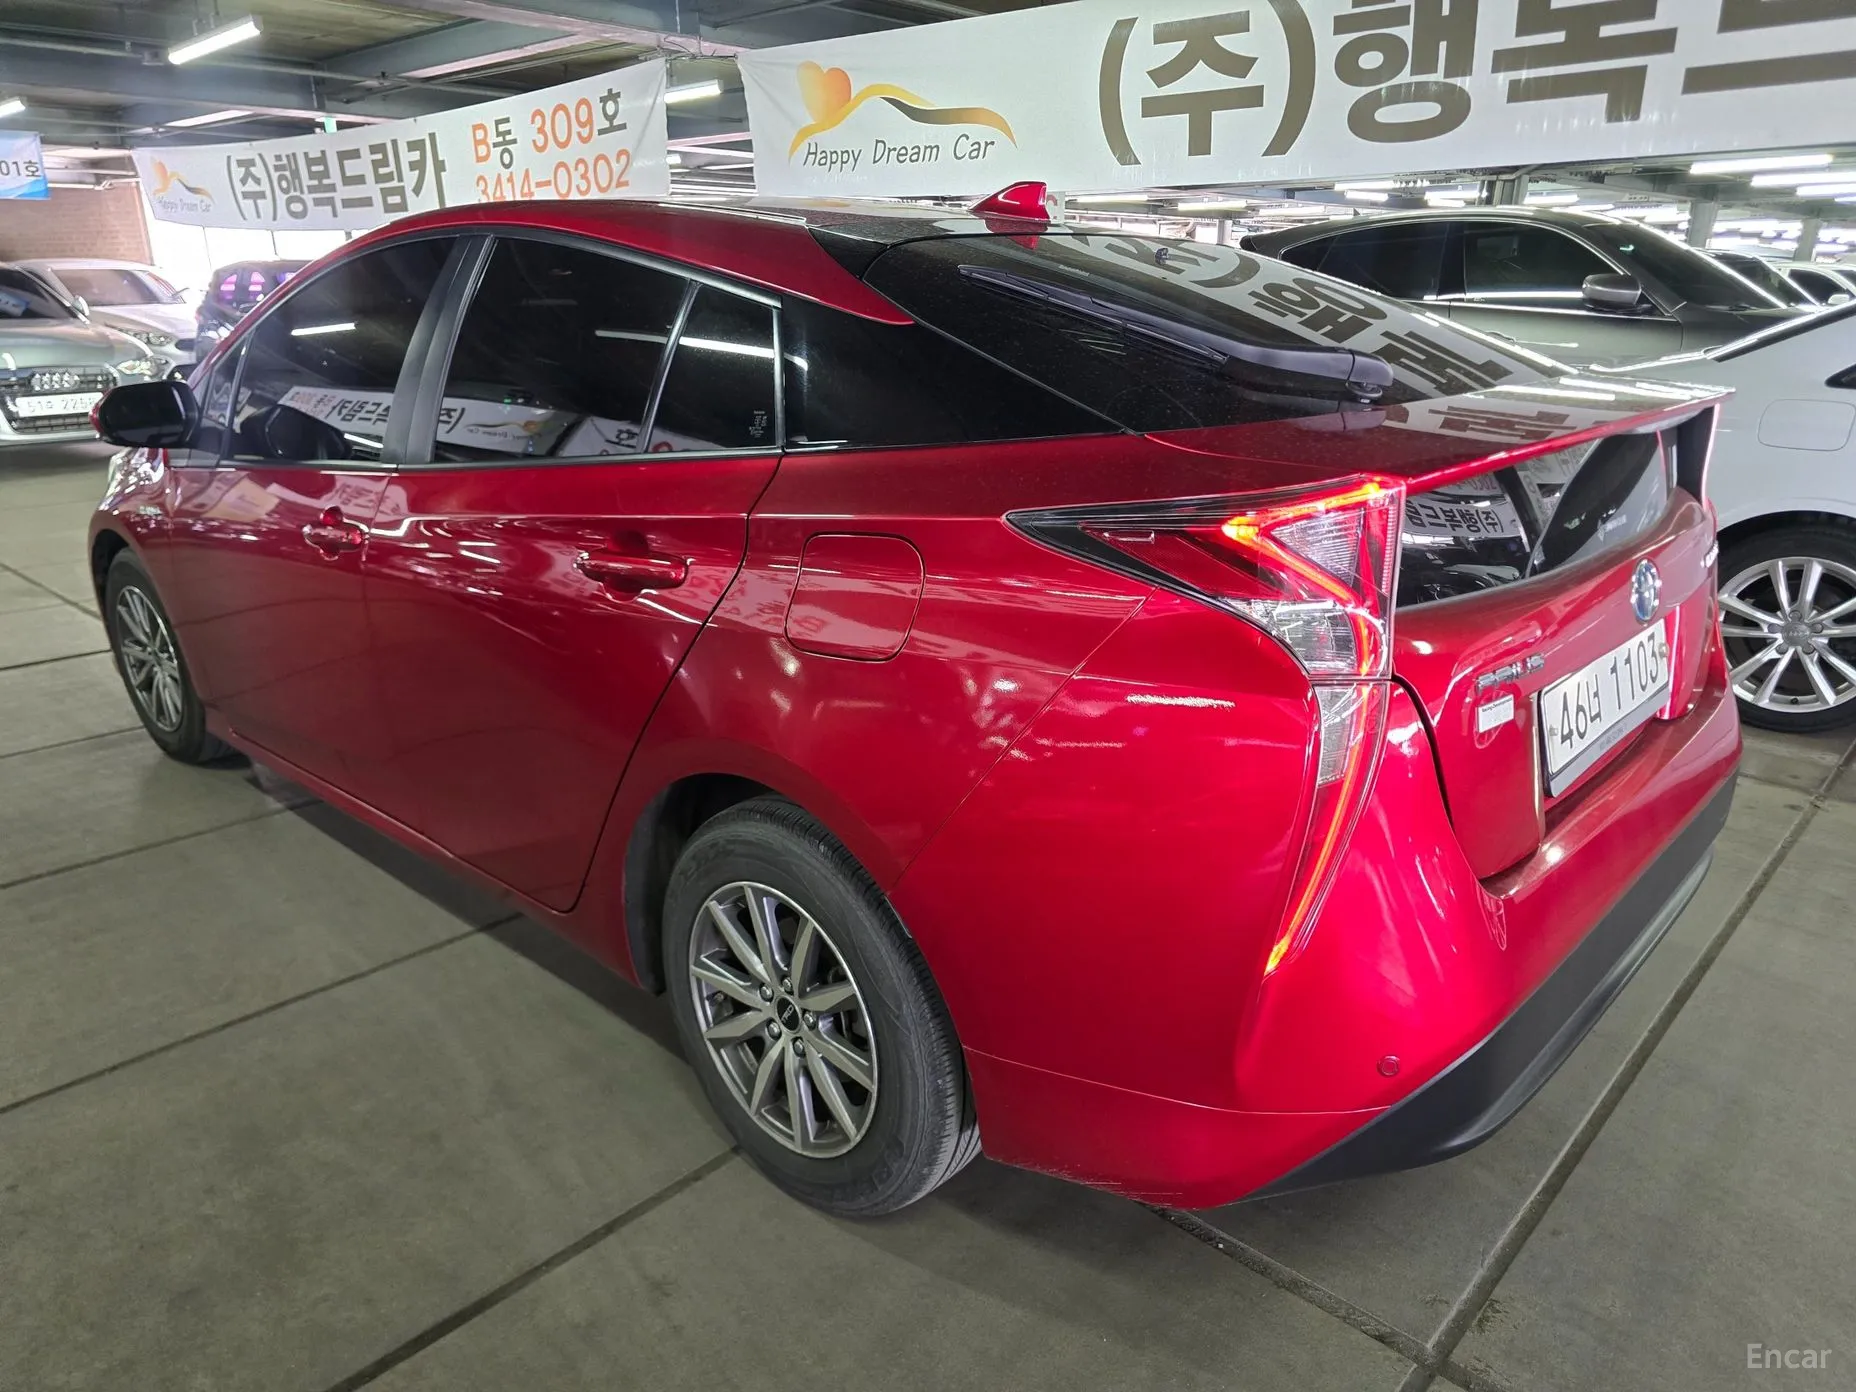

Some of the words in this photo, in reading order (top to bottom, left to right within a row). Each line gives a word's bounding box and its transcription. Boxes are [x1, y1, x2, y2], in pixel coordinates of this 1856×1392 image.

[471, 116, 518, 170] B동
[530, 87, 628, 154] 309호
[803, 142, 862, 173] Happy
[872, 138, 940, 165] Dream
[953, 133, 995, 161] Car
[226, 131, 447, 221] (주)행복드림카
[476, 148, 631, 203] 3414-0302
[1560, 673, 1602, 749] 46너
[1610, 631, 1659, 711] 1103
